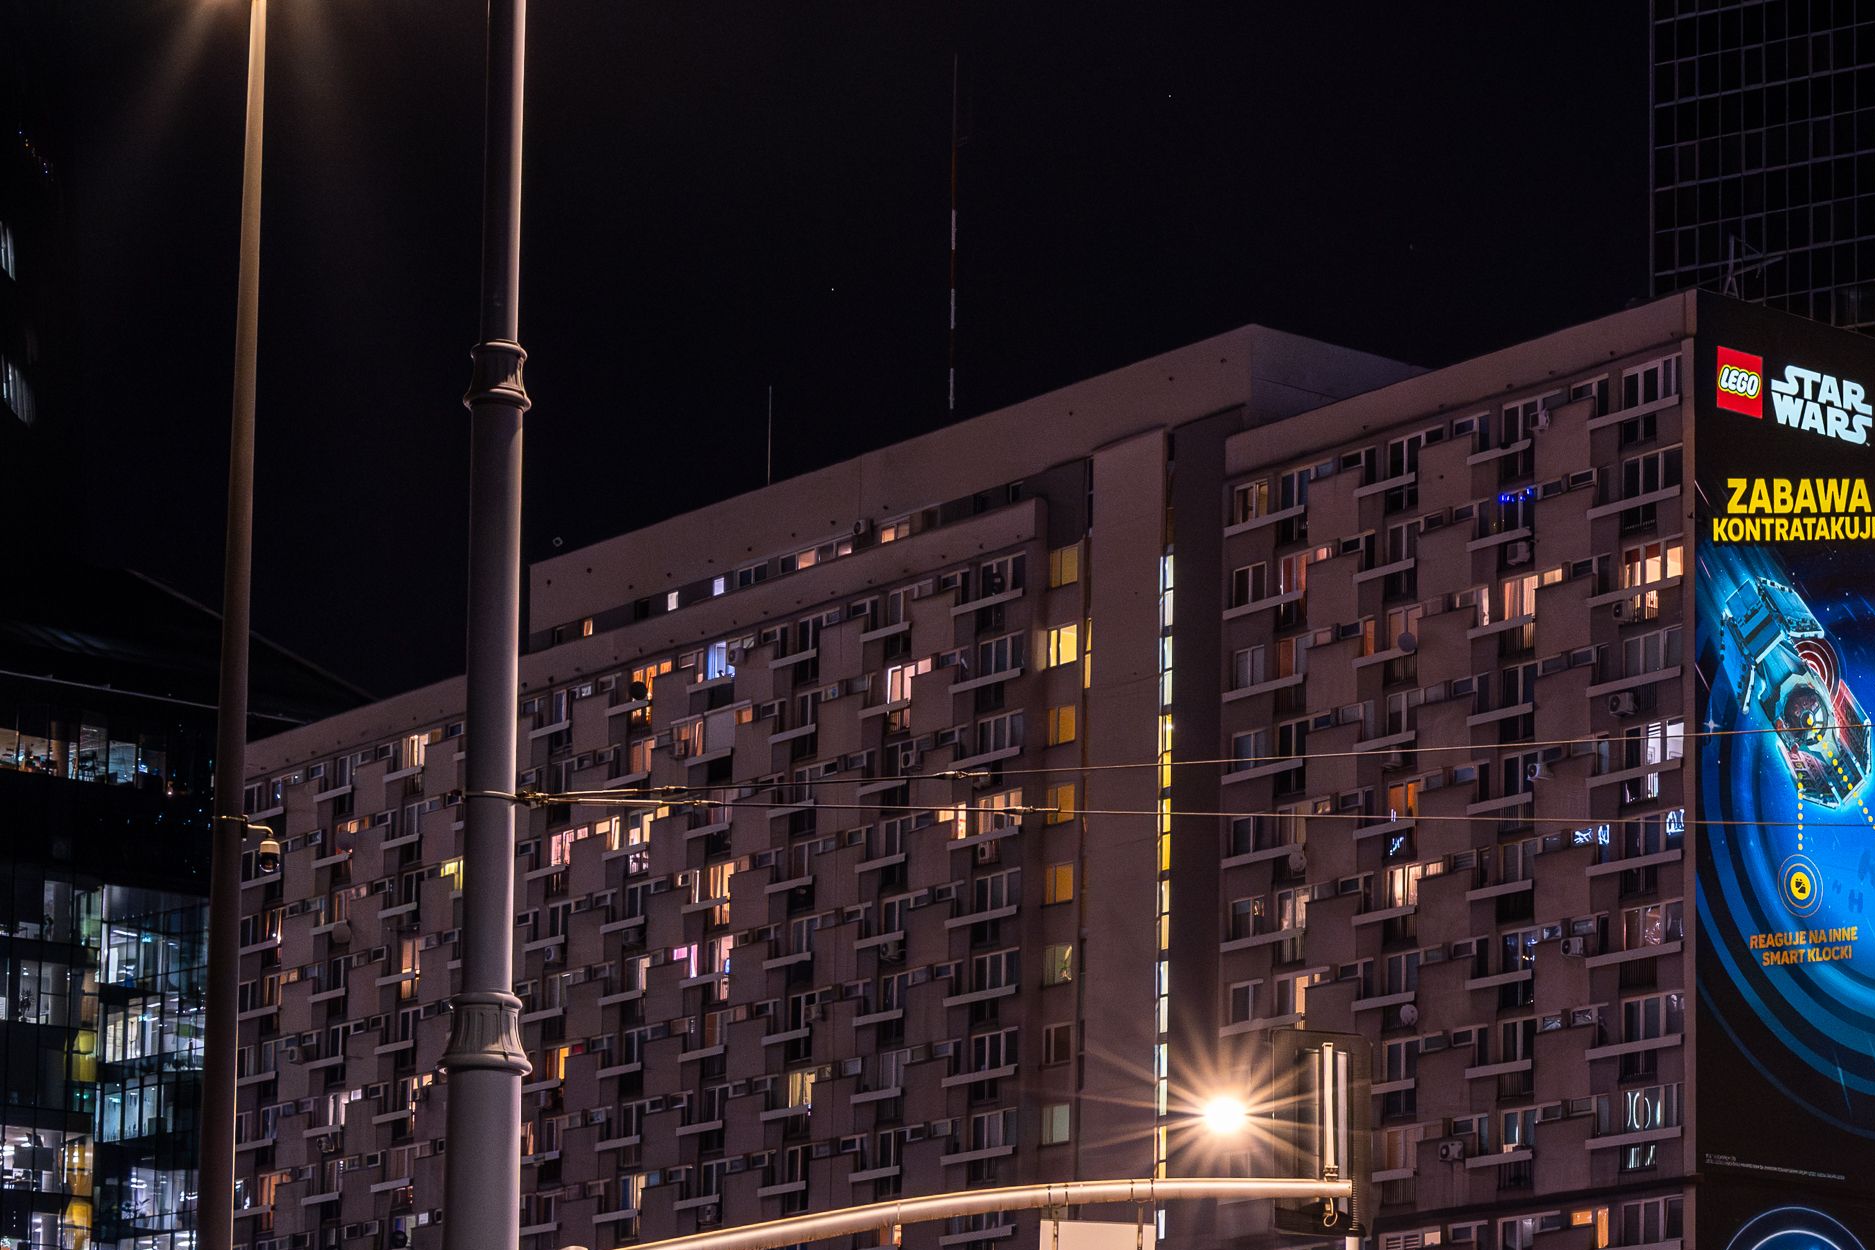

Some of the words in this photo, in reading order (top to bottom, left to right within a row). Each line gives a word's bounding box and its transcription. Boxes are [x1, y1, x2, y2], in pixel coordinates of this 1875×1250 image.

[1720, 367, 1760, 398] LEGO
[1771, 365, 1873, 416] STAR
[1771, 391, 1873, 445] WARS
[1727, 478, 1872, 514] ZABAWA
[1749, 930, 1808, 951] REAGUJE
[1808, 929, 1827, 945] NA
[1829, 926, 1858, 943] INNE
[1762, 947, 1805, 967] SMART
[1807, 945, 1853, 964] KLOCKI
